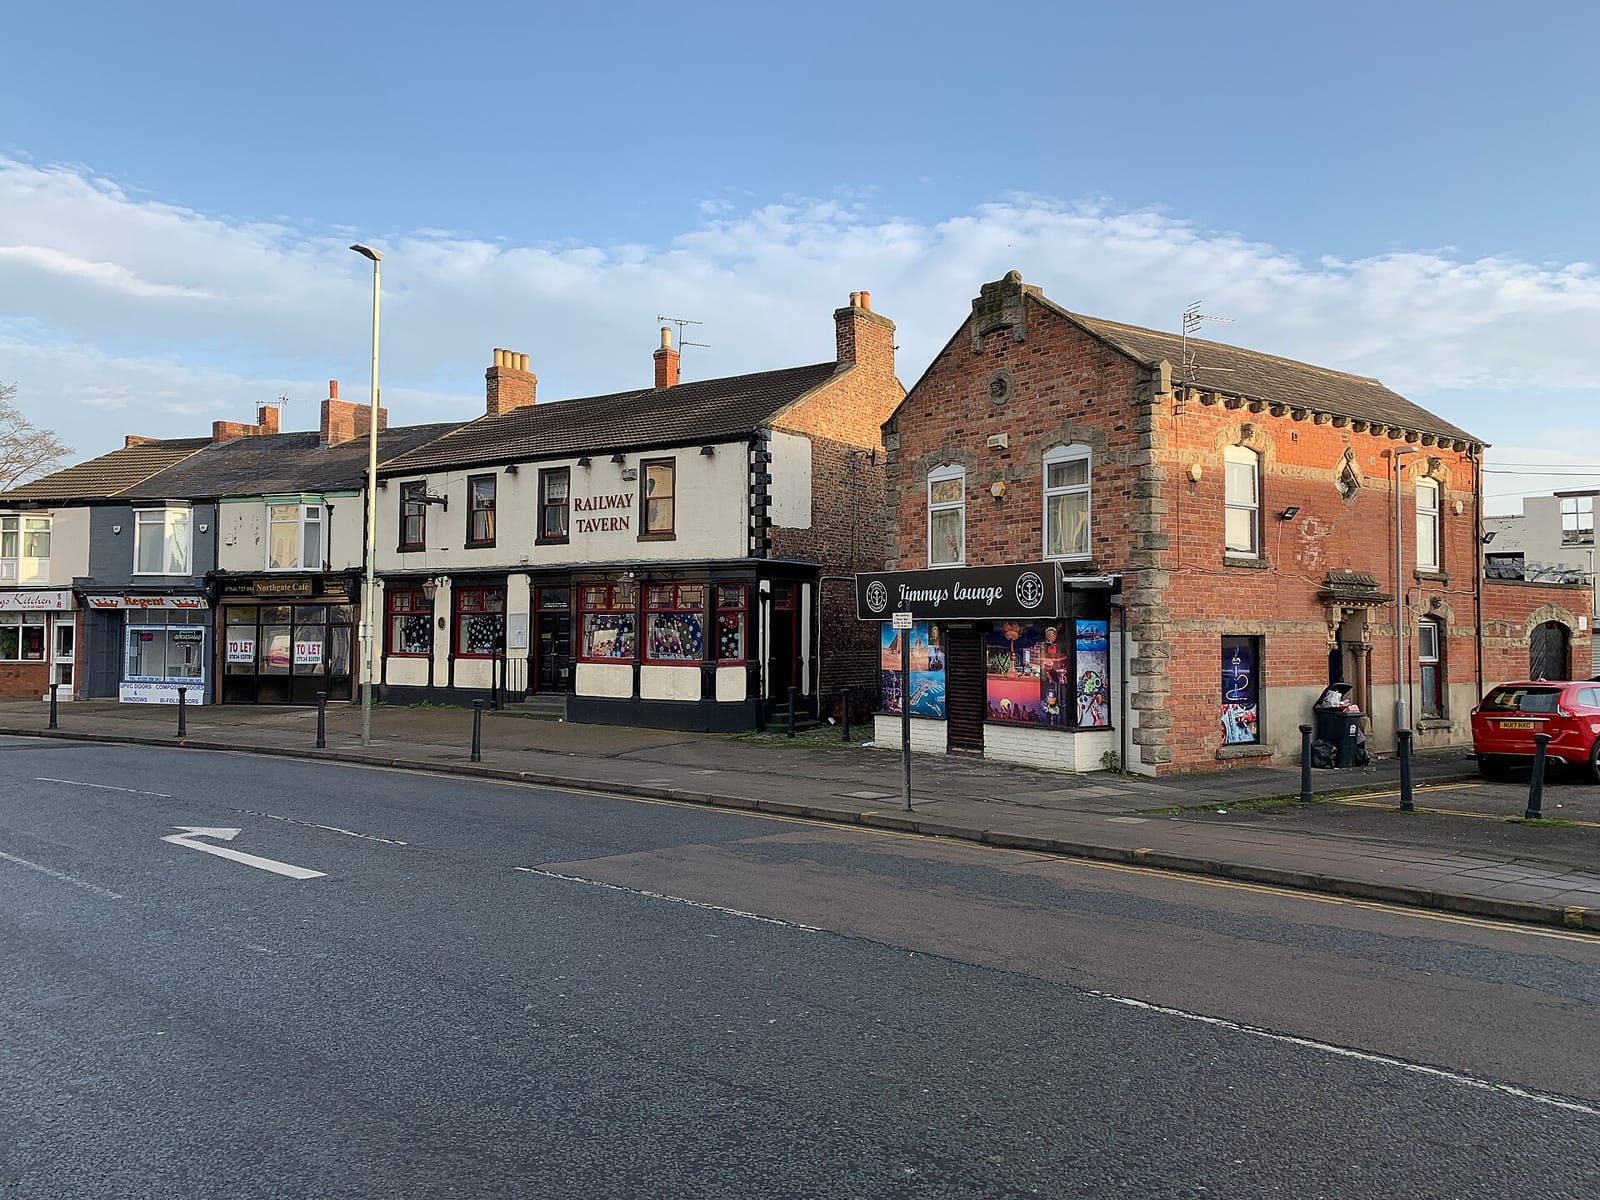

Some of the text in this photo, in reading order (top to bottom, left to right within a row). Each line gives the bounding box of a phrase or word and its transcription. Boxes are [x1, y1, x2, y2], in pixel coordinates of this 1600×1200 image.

[574, 493, 634, 512] RAILWAY
[576, 516, 630, 533] TAVERN
[256, 582, 291, 593] Northgate
[292, 582, 310, 592] Café
[13, 593, 52, 605] Kitchen
[897, 582, 1004, 608] Jimmys lounge
[124, 596, 166, 609] Regent
[229, 641, 253, 653] TO LET
[296, 643, 321, 655] TO LET
